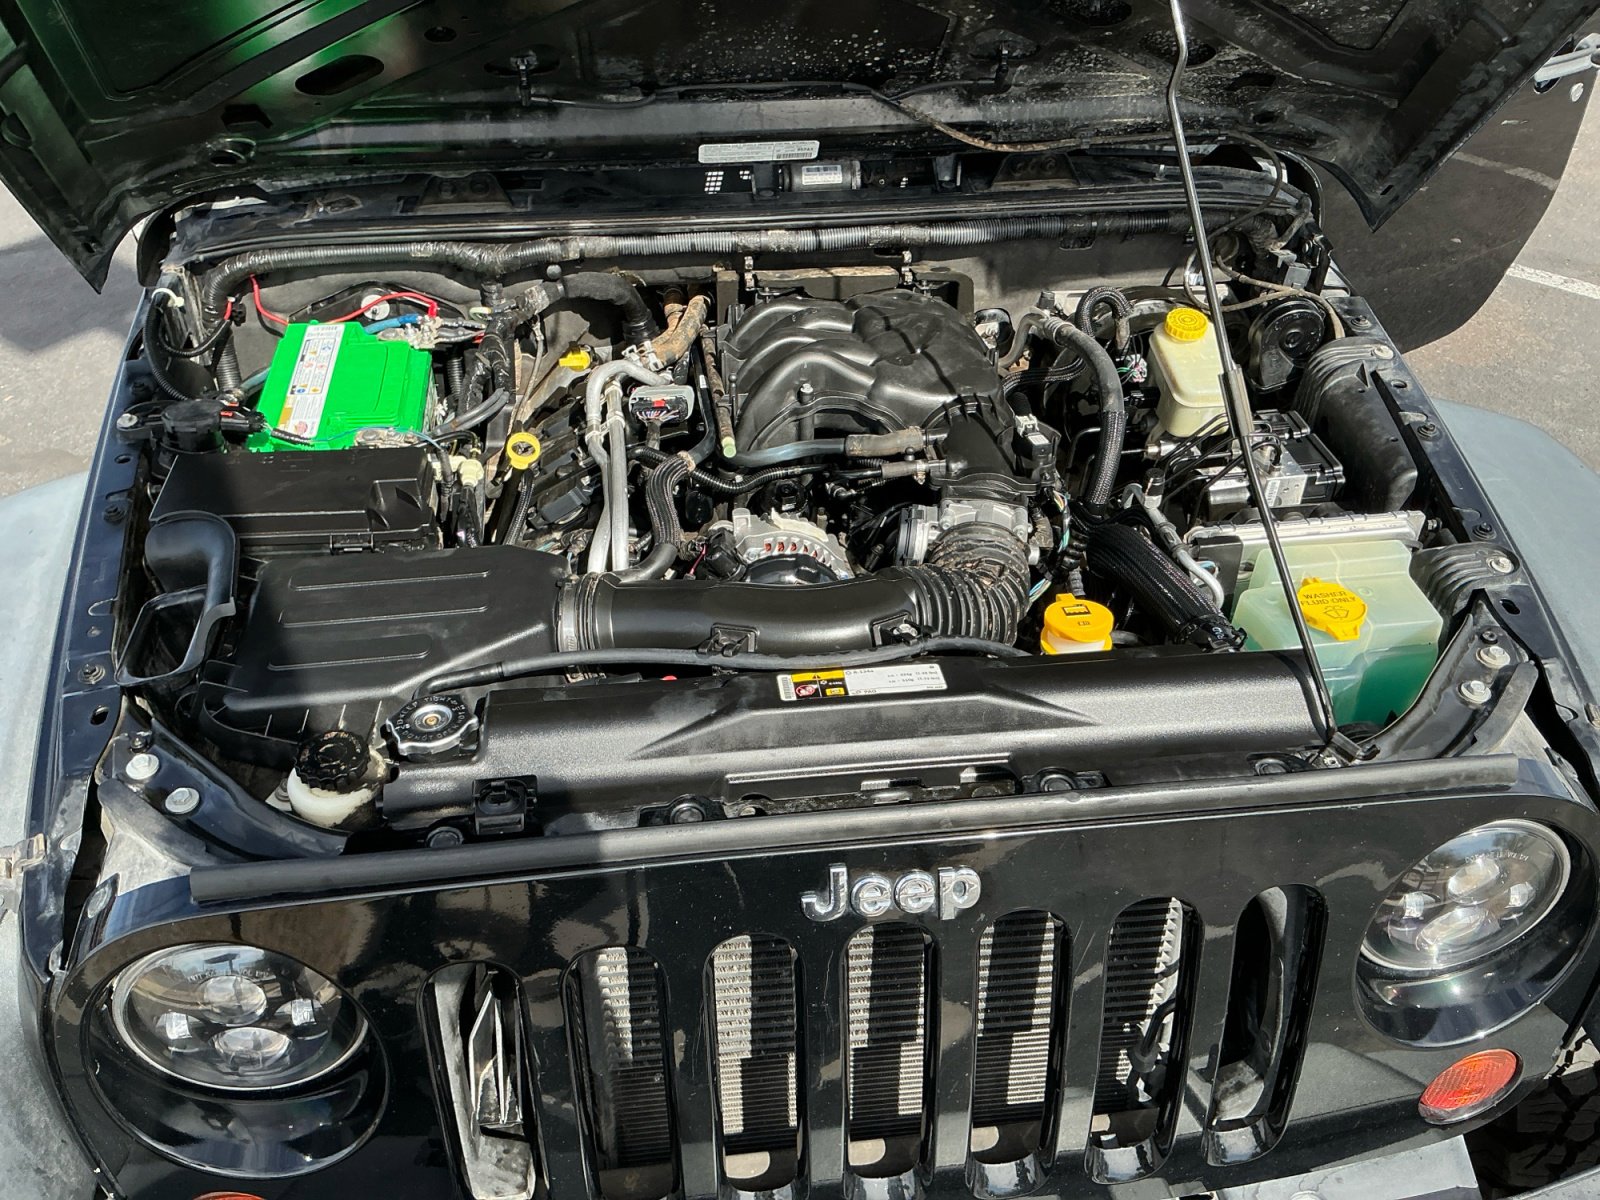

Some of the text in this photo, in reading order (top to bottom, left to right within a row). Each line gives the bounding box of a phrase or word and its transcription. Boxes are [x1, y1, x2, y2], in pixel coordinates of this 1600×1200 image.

[1303, 591, 1347, 599] WASHER
[1331, 596, 1356, 604] ONLY
[801, 863, 981, 921] Jeep
